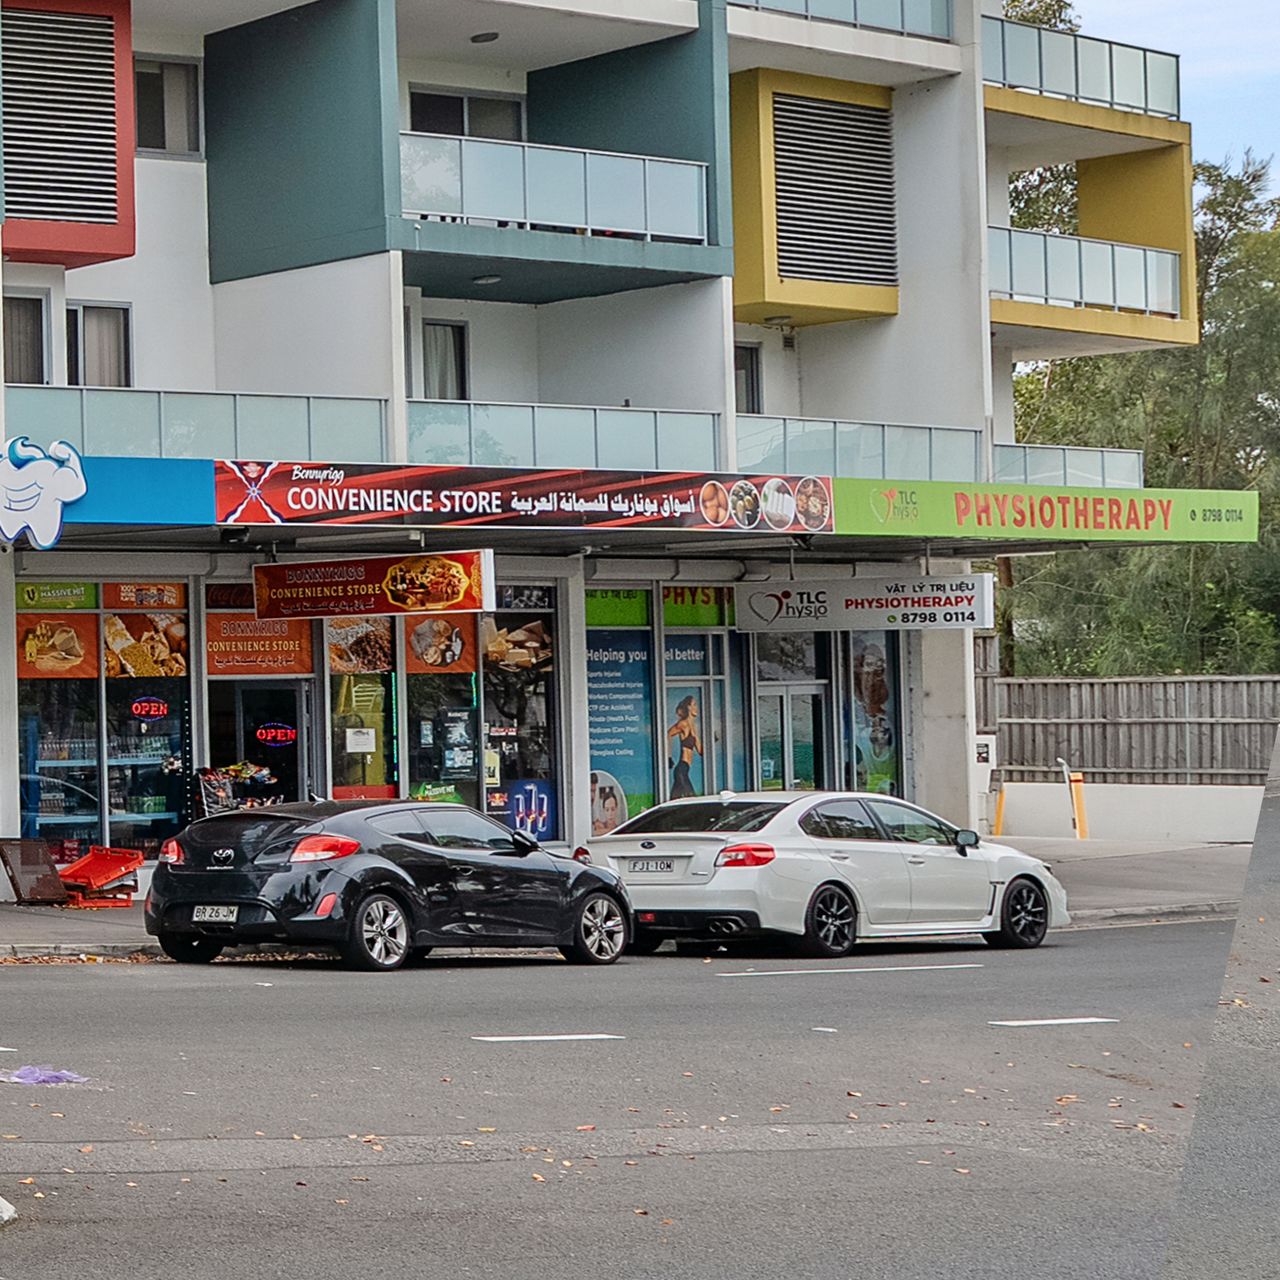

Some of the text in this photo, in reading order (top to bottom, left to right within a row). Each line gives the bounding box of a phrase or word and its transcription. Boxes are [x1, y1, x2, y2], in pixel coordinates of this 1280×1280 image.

[292, 465, 345, 486] Bonnyrigg
[288, 487, 502, 513] CONVENIENCE STORE
[898, 491, 917, 505] TLC
[954, 491, 1174, 531] PHYSIOTHERAPY
[1201, 508, 1243, 523] 8798 0114
[270, 583, 381, 599] CONVENIENCE STORE
[797, 590, 827, 605] TLC
[844, 595, 976, 609] PHYSIOTHERAPY
[900, 611, 976, 623] 8798 0114
[207, 640, 300, 651] CONVENIENCE STORE
[587, 648, 625, 663] Helping
[628, 650, 647, 663] you
[675, 649, 704, 661] better
[131, 702, 168, 715] OPEN
[256, 728, 297, 741] OPEN
